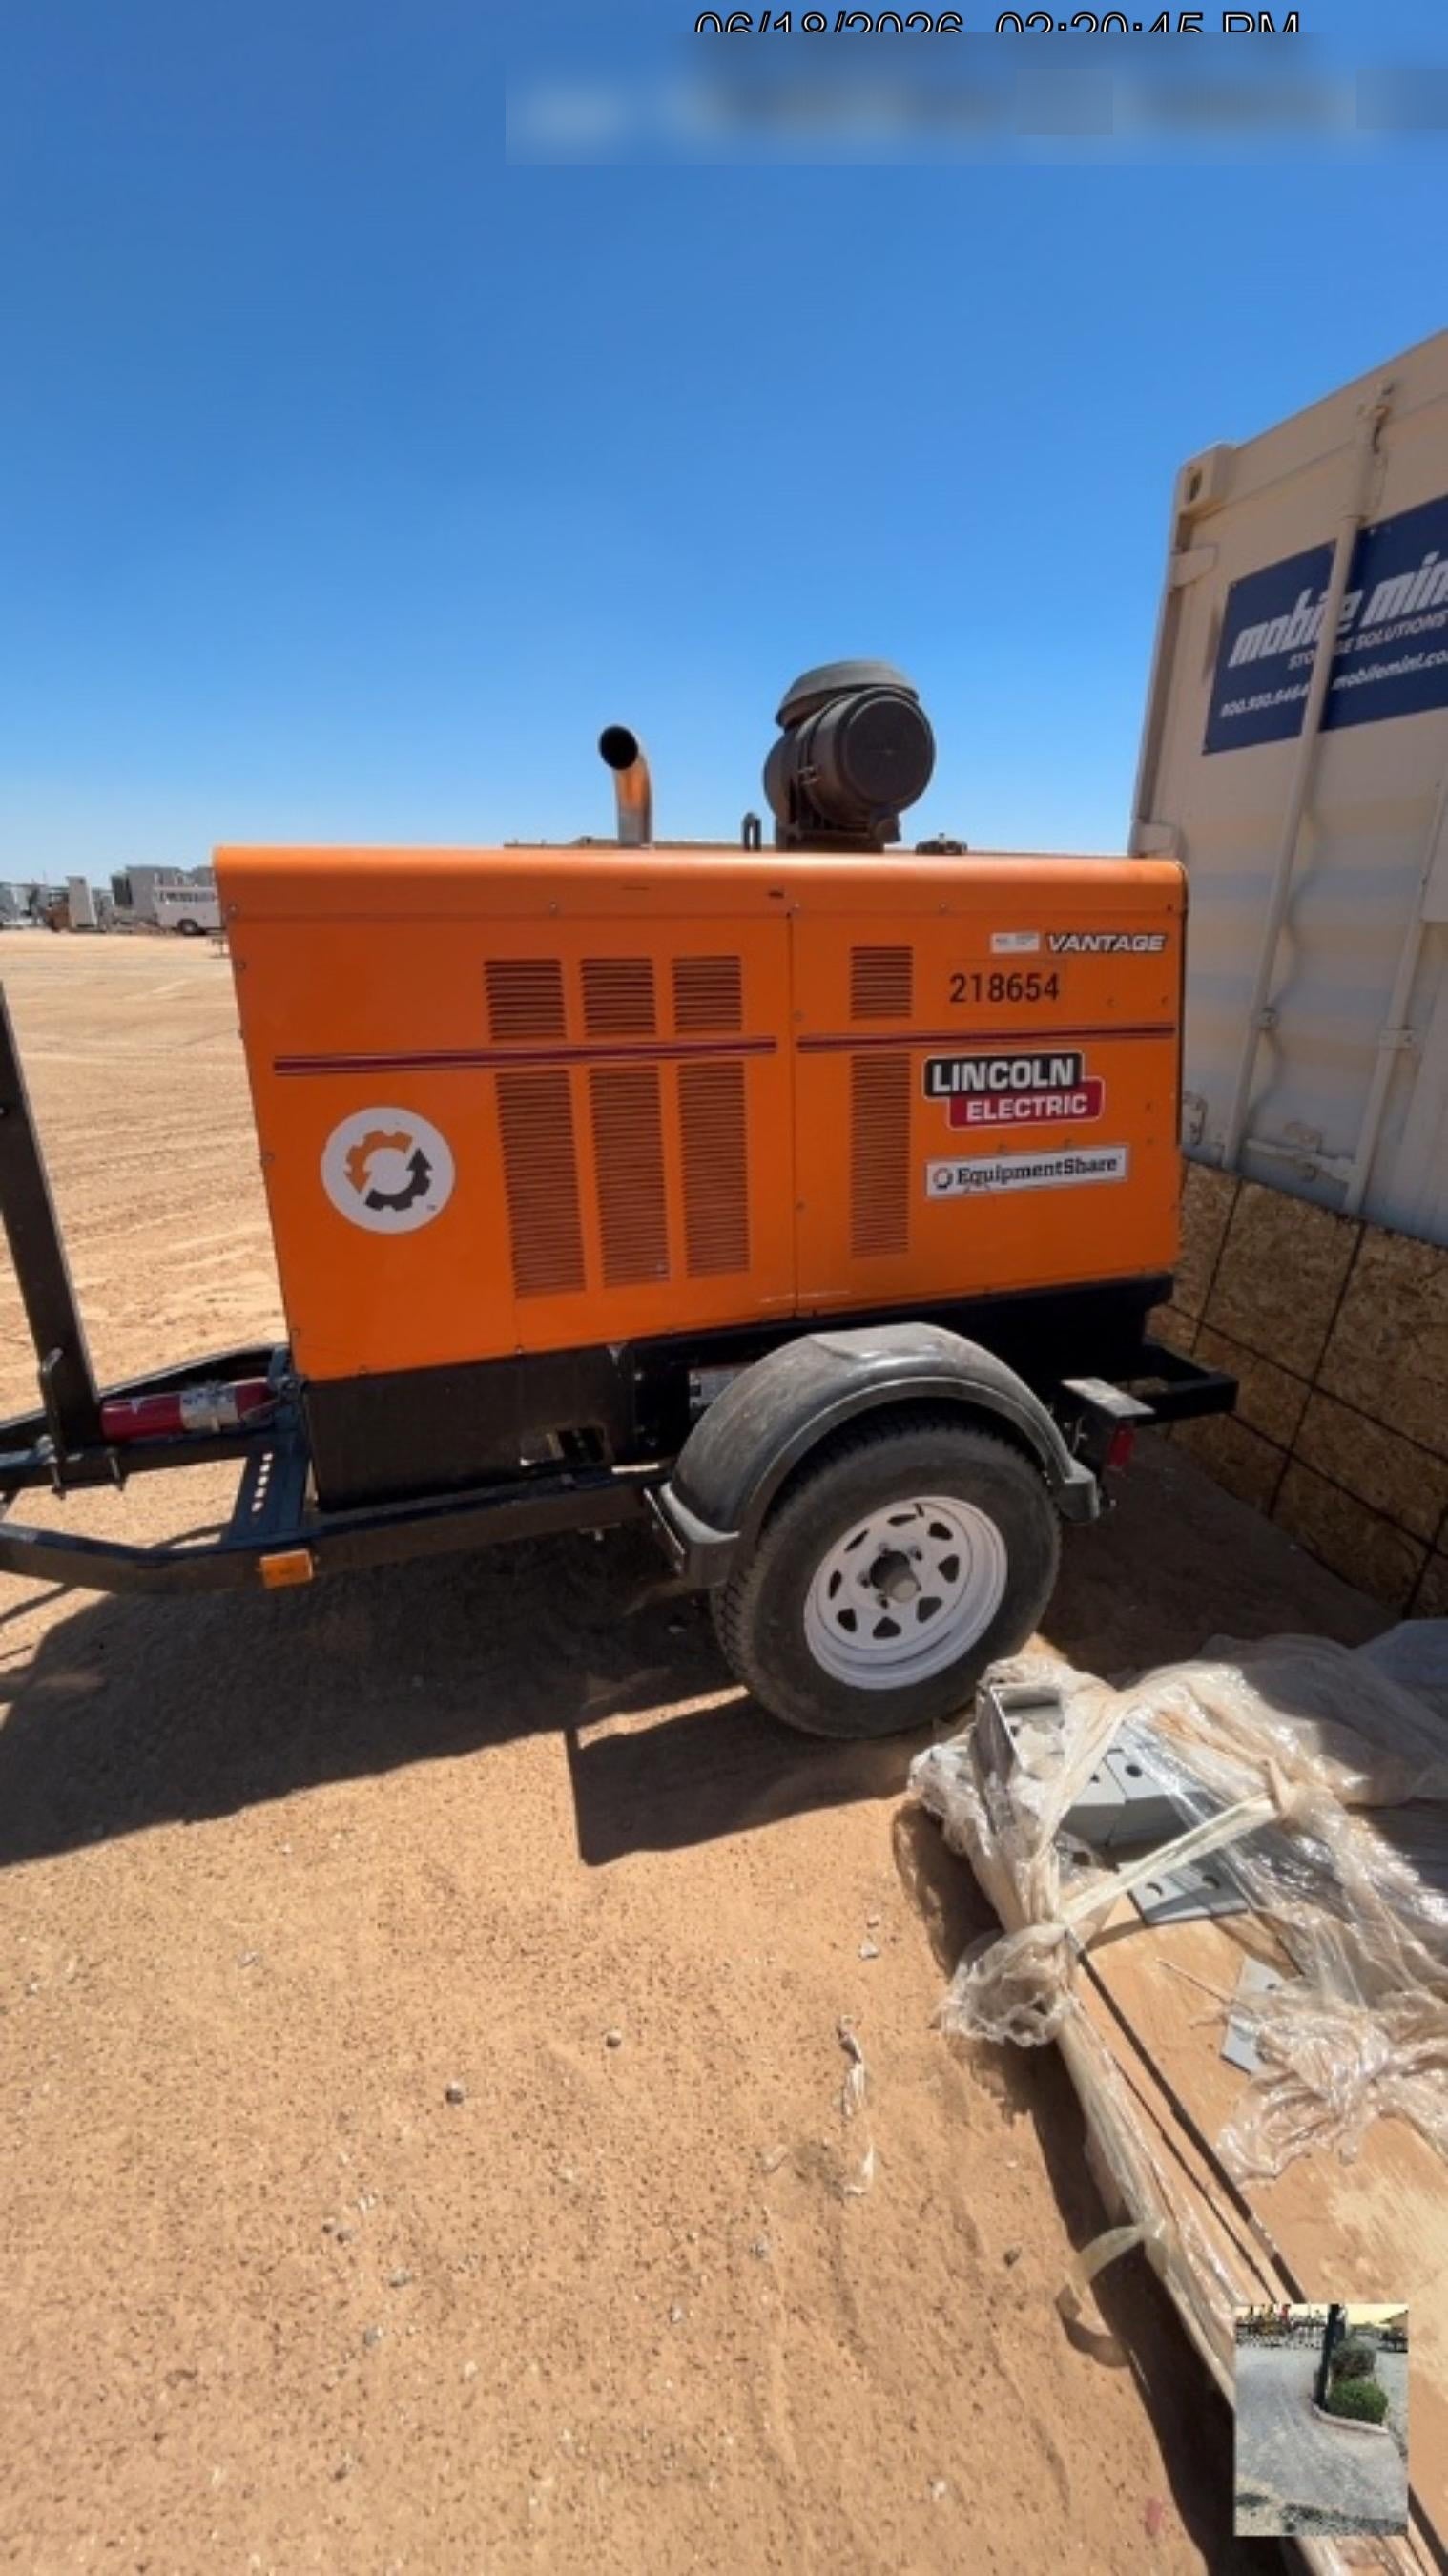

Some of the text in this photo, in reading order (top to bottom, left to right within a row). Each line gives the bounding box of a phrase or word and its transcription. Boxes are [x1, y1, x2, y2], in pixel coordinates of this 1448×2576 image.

[1227, 588, 1363, 669] mobie
[1048, 933, 1166, 953] VANTAGE
[949, 972, 1060, 1003] 218654
[931, 1056, 1075, 1094] LINCOLN
[965, 1092, 1089, 1123] ELECTRIC
[957, 1153, 1118, 1186] EquipmentShare
